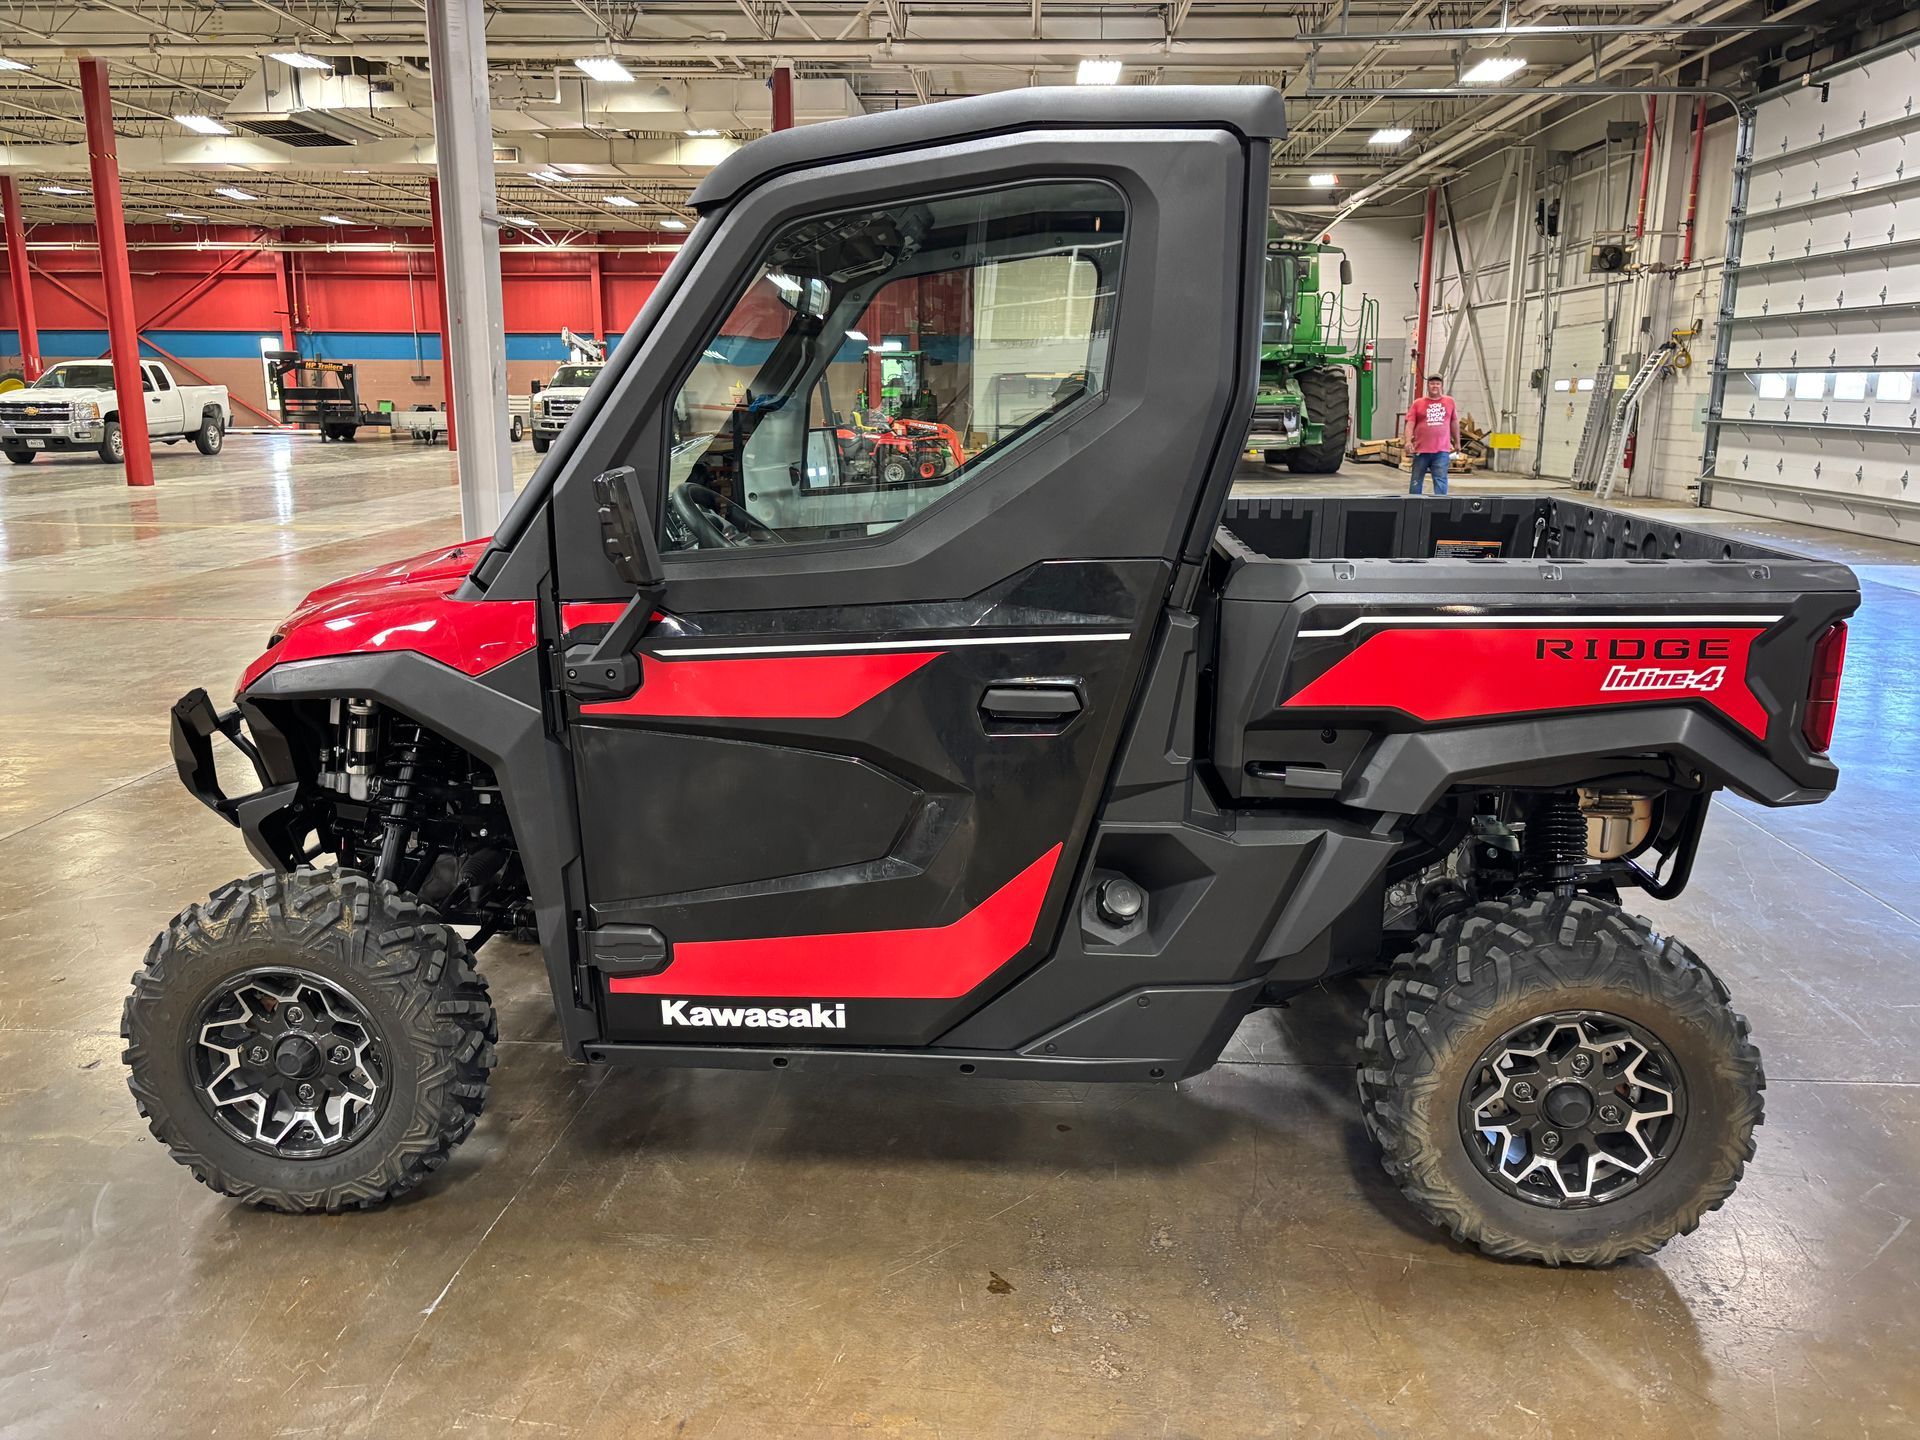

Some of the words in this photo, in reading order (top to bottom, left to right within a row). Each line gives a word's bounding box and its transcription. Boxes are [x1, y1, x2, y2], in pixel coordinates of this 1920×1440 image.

[318, 362, 343, 370] Trailers
[1535, 638, 1731, 660] RIDGE
[1600, 665, 1727, 691] Inline-4
[660, 999, 846, 1029] Kawasaki
